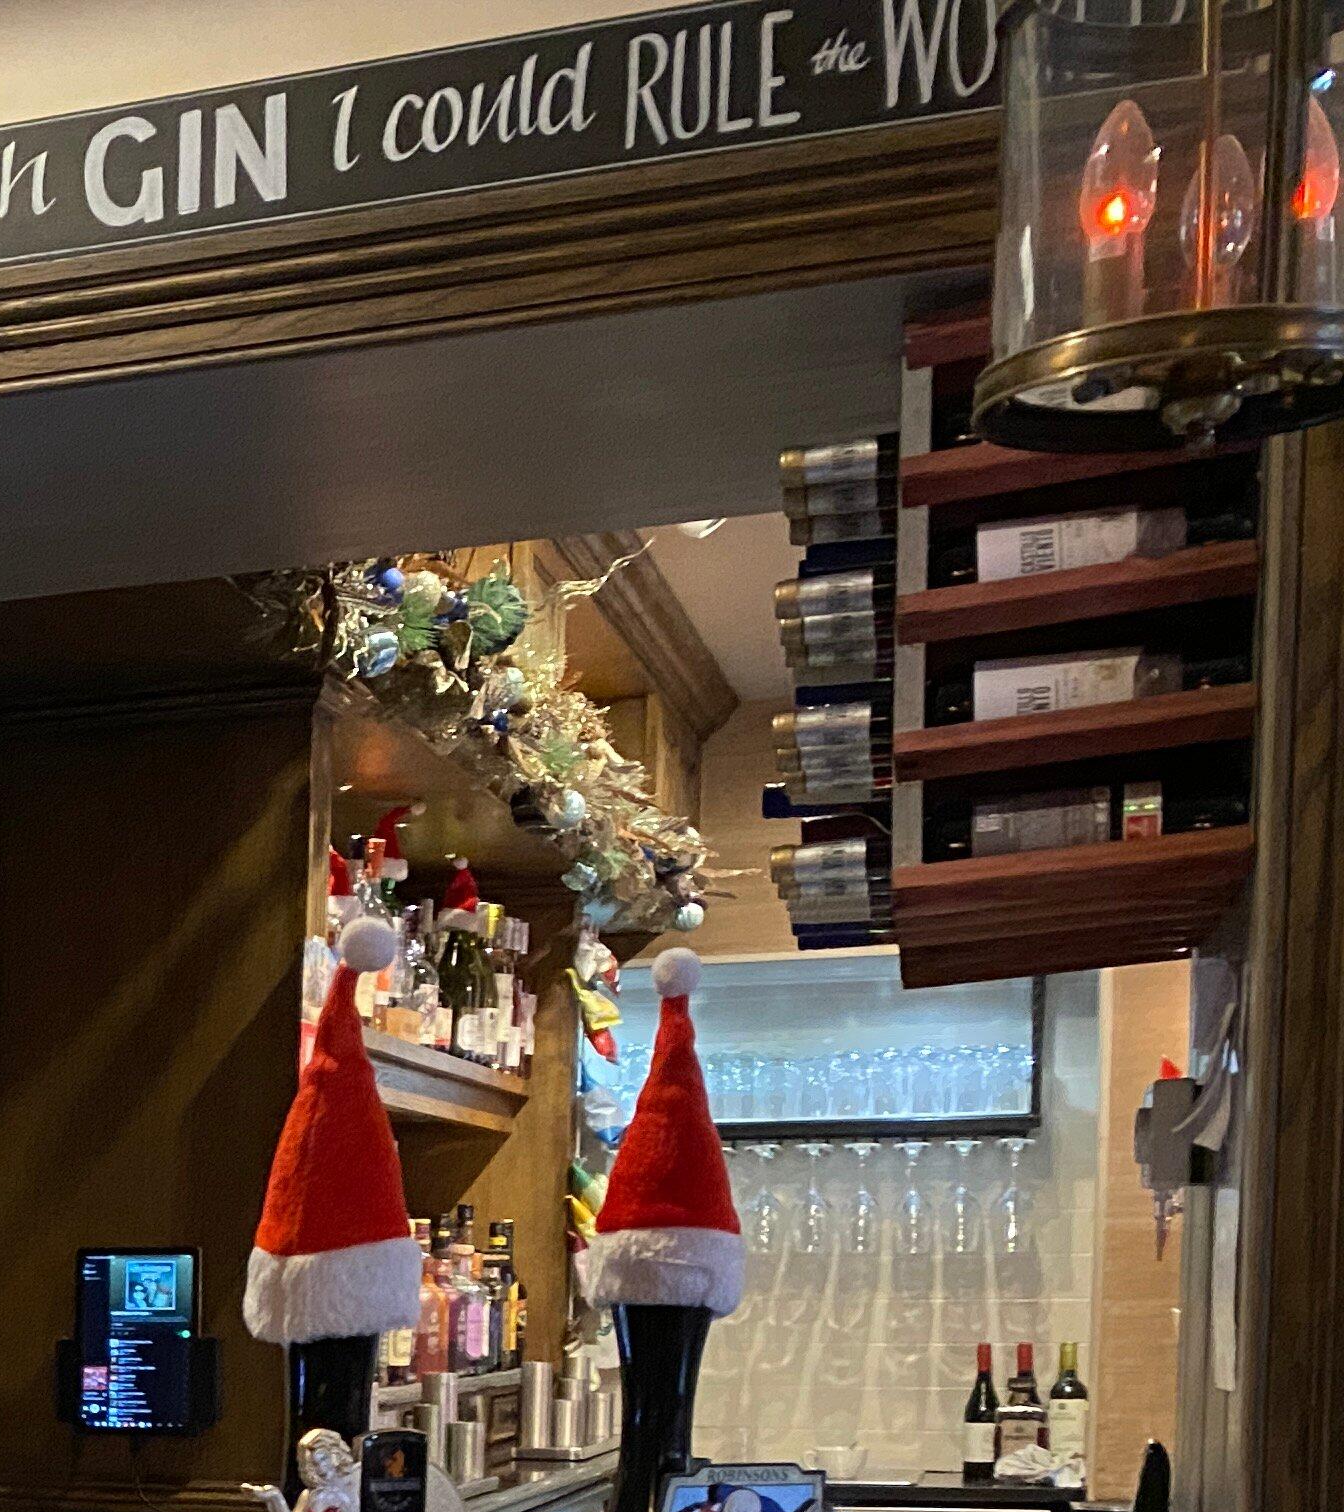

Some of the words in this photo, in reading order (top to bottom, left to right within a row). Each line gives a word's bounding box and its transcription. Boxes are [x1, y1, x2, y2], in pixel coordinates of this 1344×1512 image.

[84, 93, 288, 227] GIN
[381, 41, 597, 166] could
[625, 10, 801, 148] RULE
[811, 34, 871, 74] the
